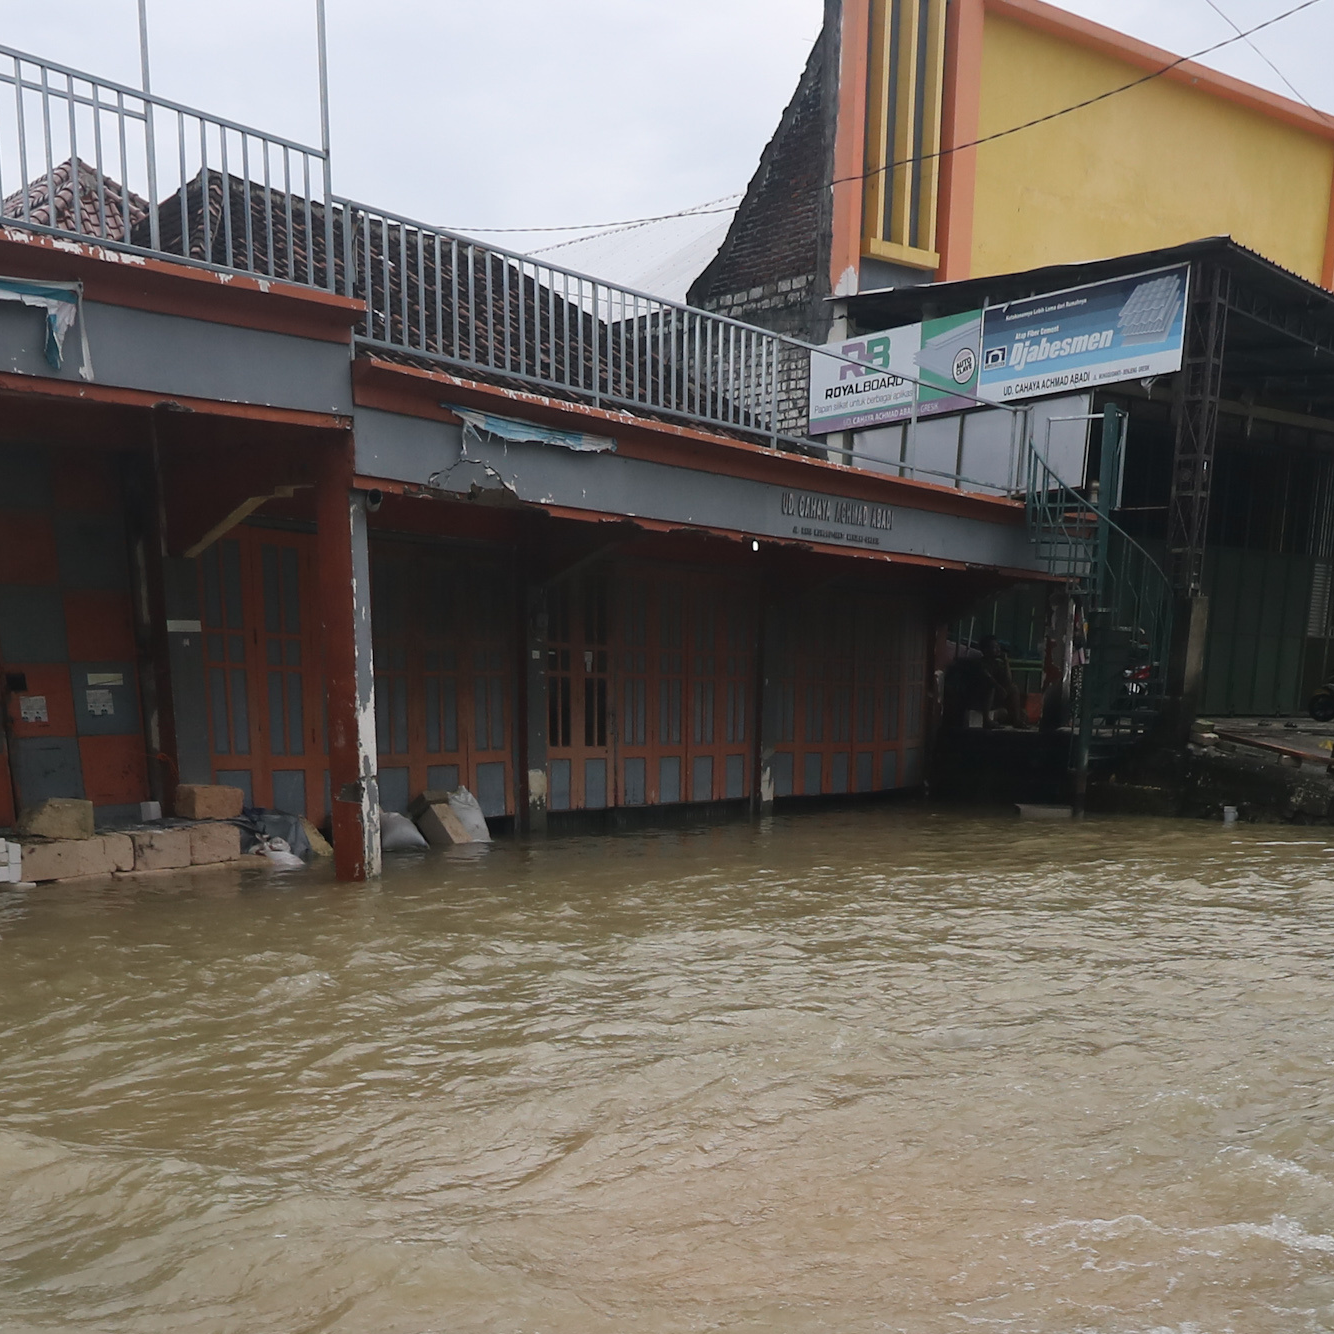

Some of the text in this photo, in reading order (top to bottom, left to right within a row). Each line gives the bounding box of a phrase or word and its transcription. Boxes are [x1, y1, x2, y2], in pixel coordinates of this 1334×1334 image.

[1015, 326, 1059, 340] Atap Fiber Cement
[1009, 329, 1114, 371] Djabesmen
[956, 357, 971, 370] AUTO
[956, 363, 973, 376] CLAVE
[825, 376, 904, 400] ROYALBOARD
[1003, 372, 1090, 396] UD. CAHAYA ACHMAD ABADI
[815, 404, 832, 414] Papan
[850, 398, 865, 408] untuk
[867, 393, 891, 406] berbagai
[893, 390, 913, 402] aplikas
[853, 414, 874, 424] CAHAYA
[875, 410, 898, 421] ACHMAD
[921, 402, 939, 413] GRESIK
[798, 496, 831, 522] CAHAYA
[834, 502, 868, 526] ACHMAD
[870, 507, 894, 530] ABADI
